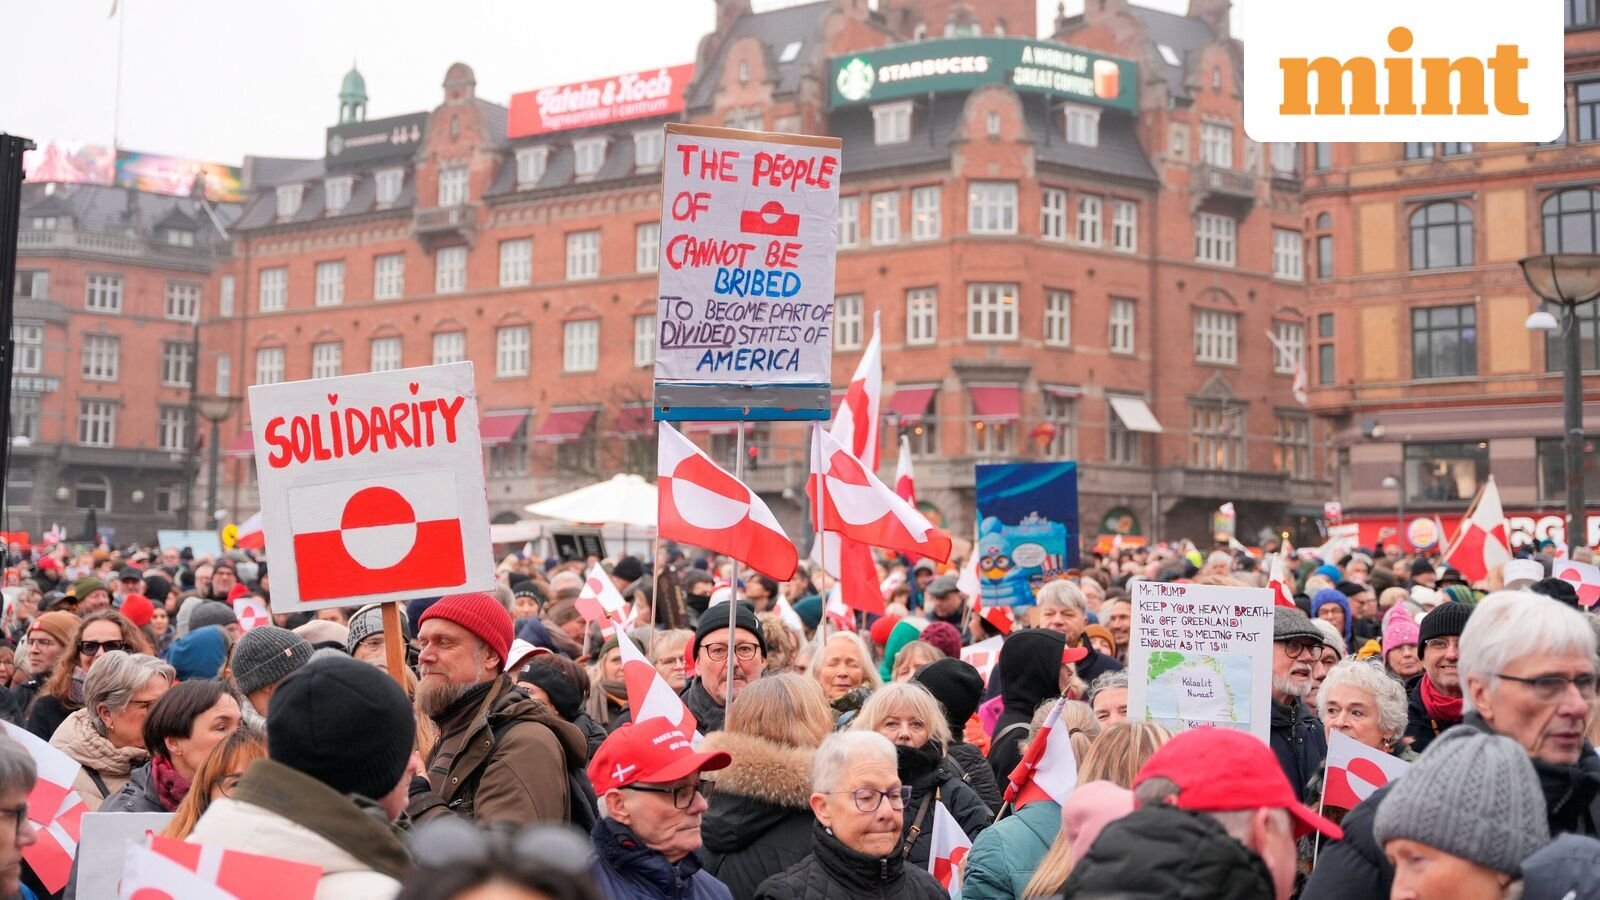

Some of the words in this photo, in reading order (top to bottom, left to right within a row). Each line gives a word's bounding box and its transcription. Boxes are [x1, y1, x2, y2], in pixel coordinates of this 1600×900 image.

[878, 56, 989, 83] STARBUCKS
[1021, 45, 1034, 64] A
[1033, 47, 1073, 71] WORLD
[1073, 54, 1088, 74] OF
[601, 80, 616, 106] &
[615, 67, 673, 102] Koch
[1013, 66, 1054, 88] GREAT
[677, 144, 740, 182] THE
[752, 151, 838, 192] PEOPLE
[671, 191, 712, 223] OF
[666, 234, 756, 270] CANNOT
[764, 240, 803, 268] BE
[713, 267, 802, 298] BRIBED
[659, 296, 694, 321] TO
[705, 299, 768, 323] BECOME
[769, 303, 812, 323] PART
[813, 303, 834, 321] OF
[738, 325, 800, 345] STATES
[803, 326, 829, 345] OF
[696, 349, 800, 372] AMERICA
[1139, 584, 1154, 596] Mr.
[1153, 584, 1186, 597] TRUMP
[1139, 600, 1167, 612] KEEP
[1170, 603, 1195, 615] YOUR
[1198, 604, 1231, 616] HEAVY
[1234, 605, 1273, 618] BREATH-
[1159, 616, 1177, 626] OFF
[1181, 616, 1243, 628] GREENLAND!
[1139, 628, 1160, 637] THE
[1195, 629, 1232, 640] MELTING
[1236, 631, 1260, 642] FAST
[1140, 638, 1176, 649] ENOUGH
[1179, 641, 1193, 651] AS
[1194, 641, 1206, 651] IT
